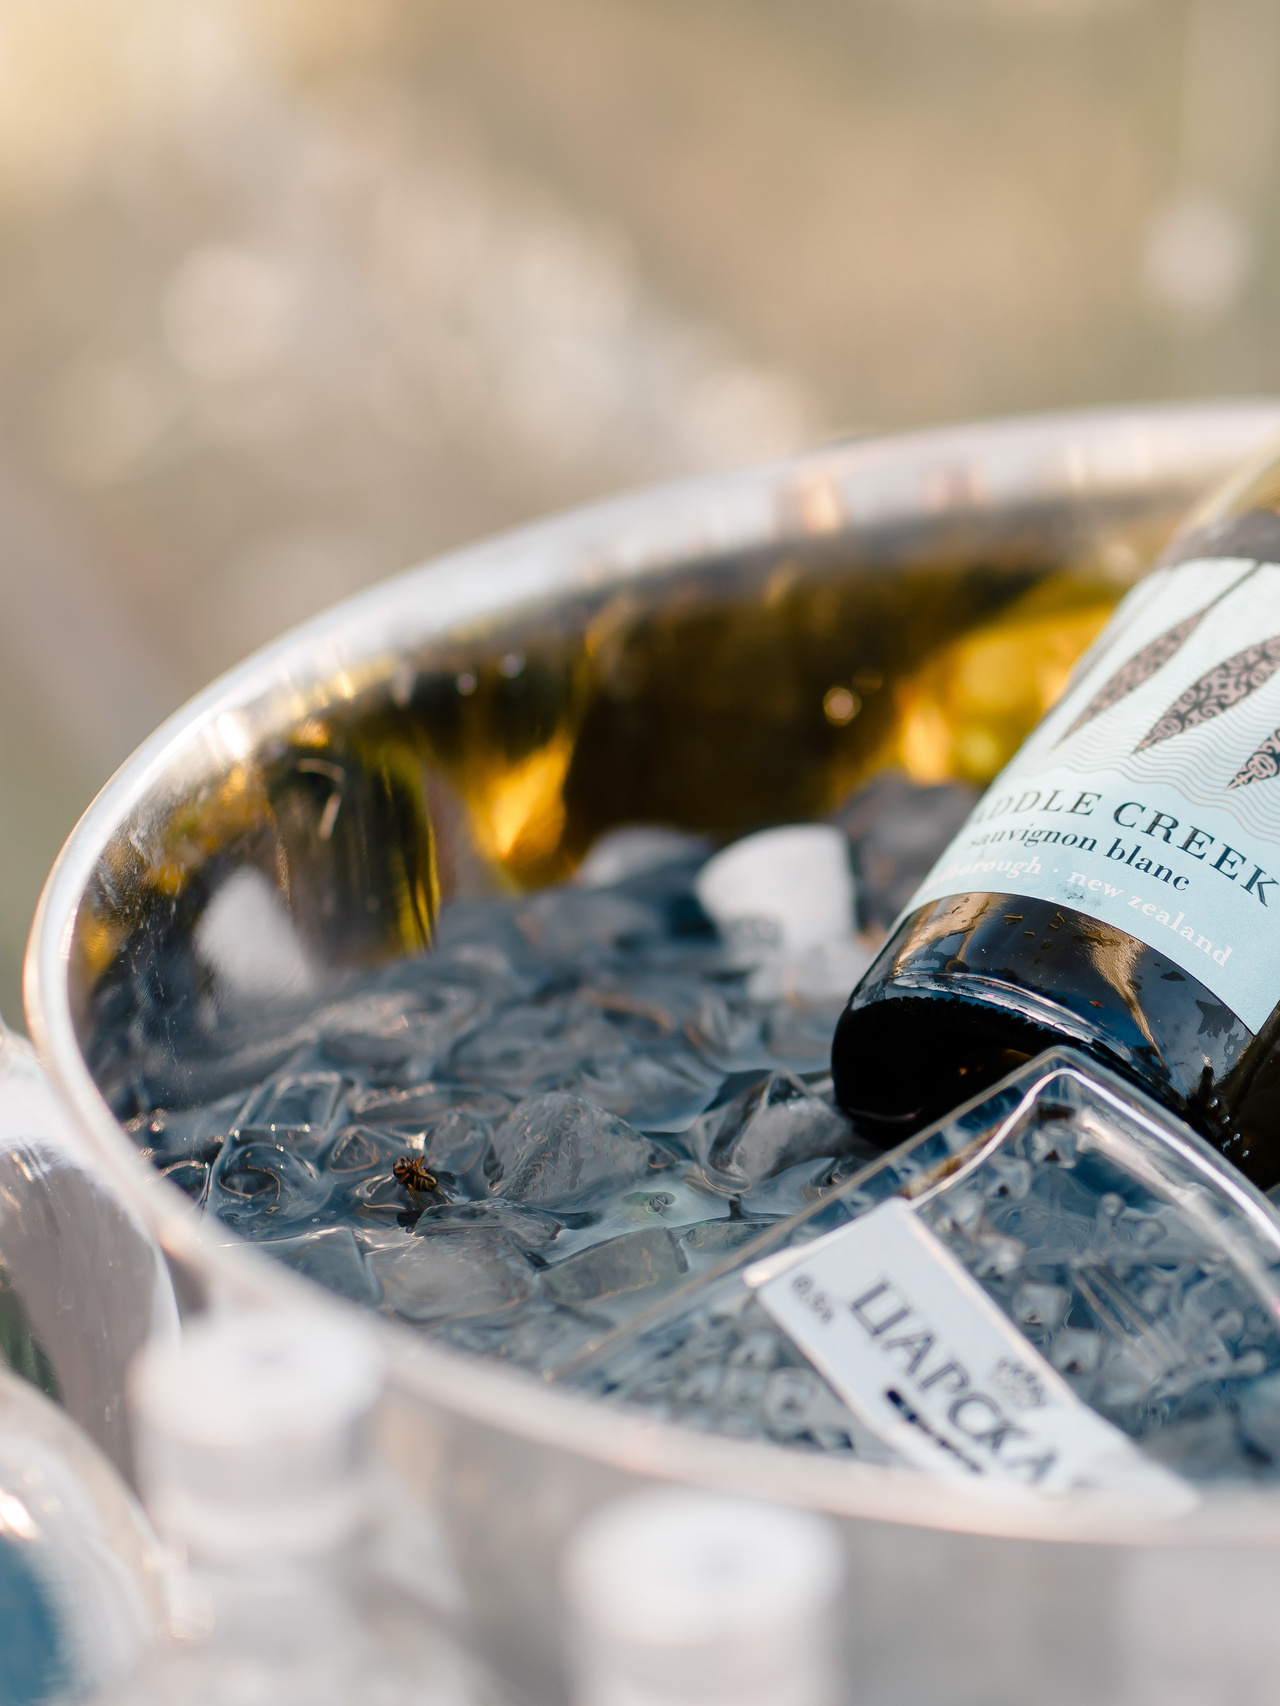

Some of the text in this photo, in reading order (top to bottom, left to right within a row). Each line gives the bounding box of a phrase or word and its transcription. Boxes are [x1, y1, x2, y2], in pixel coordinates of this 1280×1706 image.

[967, 822, 1191, 892] sauvignon blanc
[1112, 801, 1280, 908] CREEK
[1066, 870, 1124, 899] new
[1127, 894, 1234, 968] zealand
[847, 1279, 1094, 1490] ЦАРСКА
